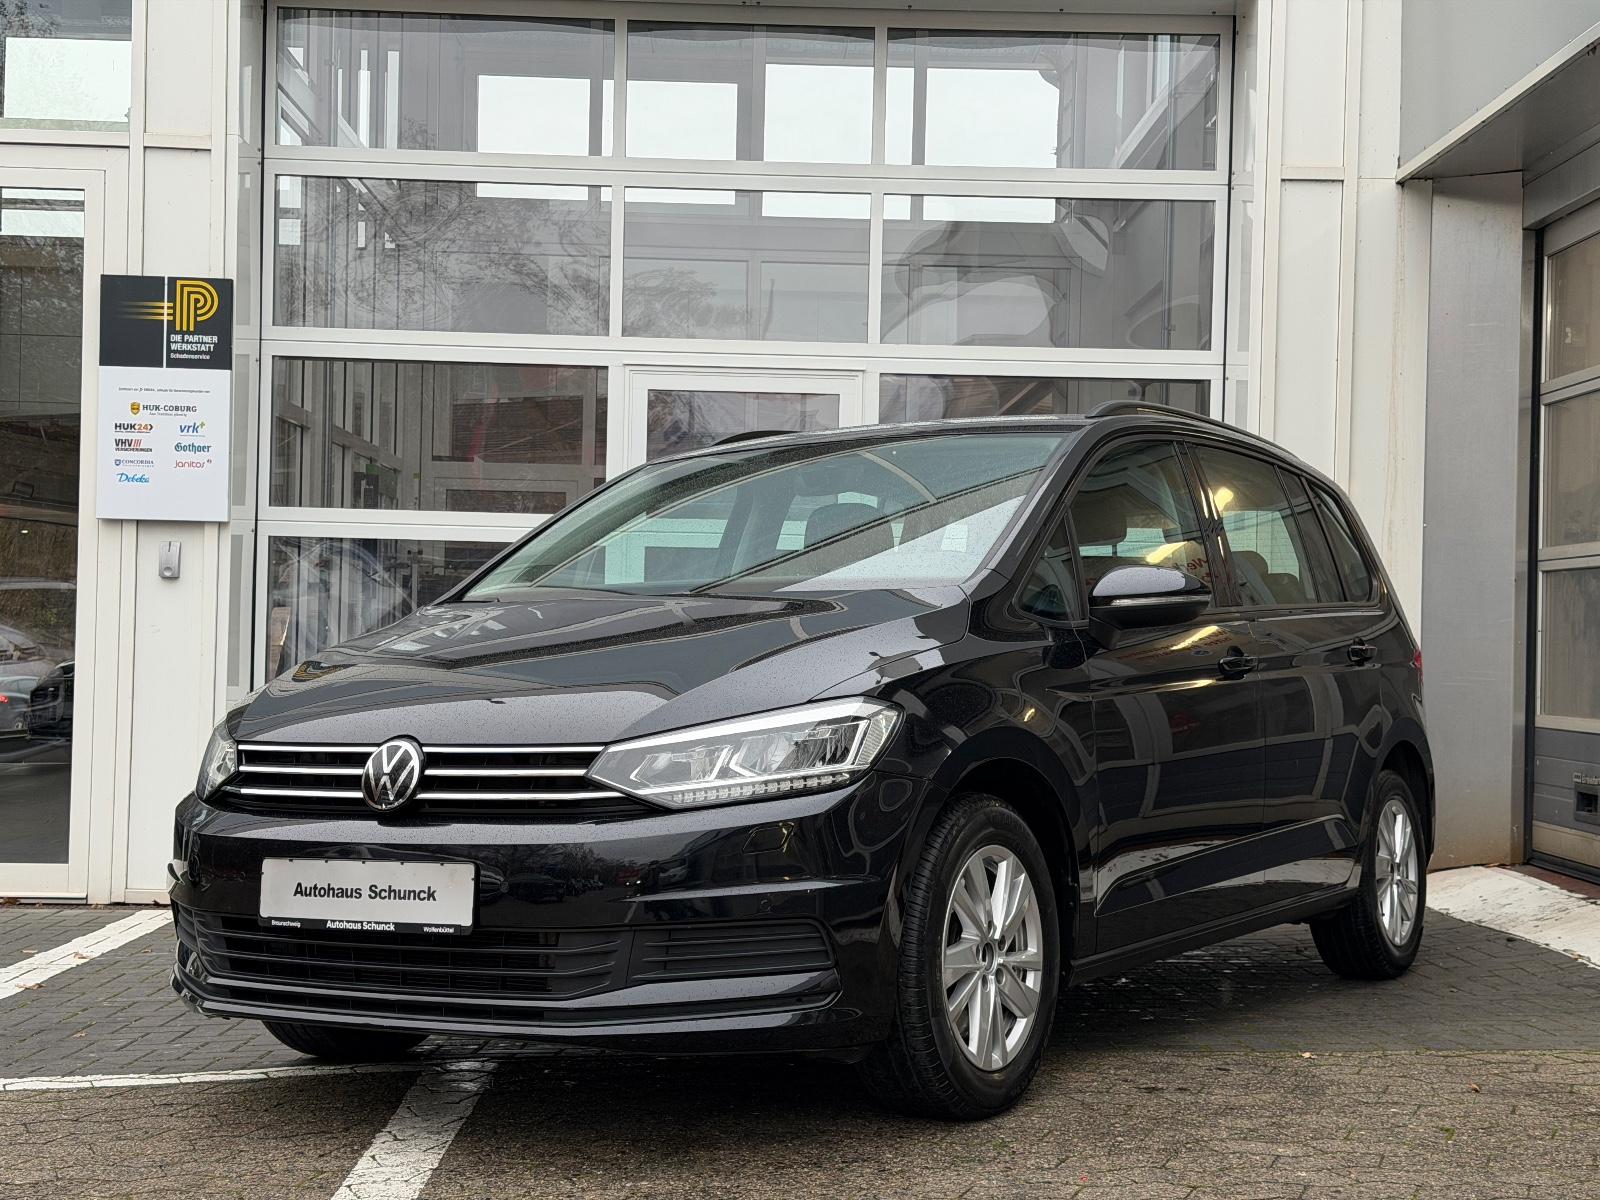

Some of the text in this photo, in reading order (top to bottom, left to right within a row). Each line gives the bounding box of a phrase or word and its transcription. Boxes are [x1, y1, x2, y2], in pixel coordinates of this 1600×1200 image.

[170, 334, 218, 343] DIE PARTNER
[170, 342, 215, 352] WERKSTATT
[170, 352, 211, 360] Schadenservice
[142, 404, 198, 413] HUK-COBURG
[174, 441, 213, 455] Gothaer
[293, 881, 437, 902] Autohaus Schunck
[326, 920, 395, 932] Autohaus Schunck
